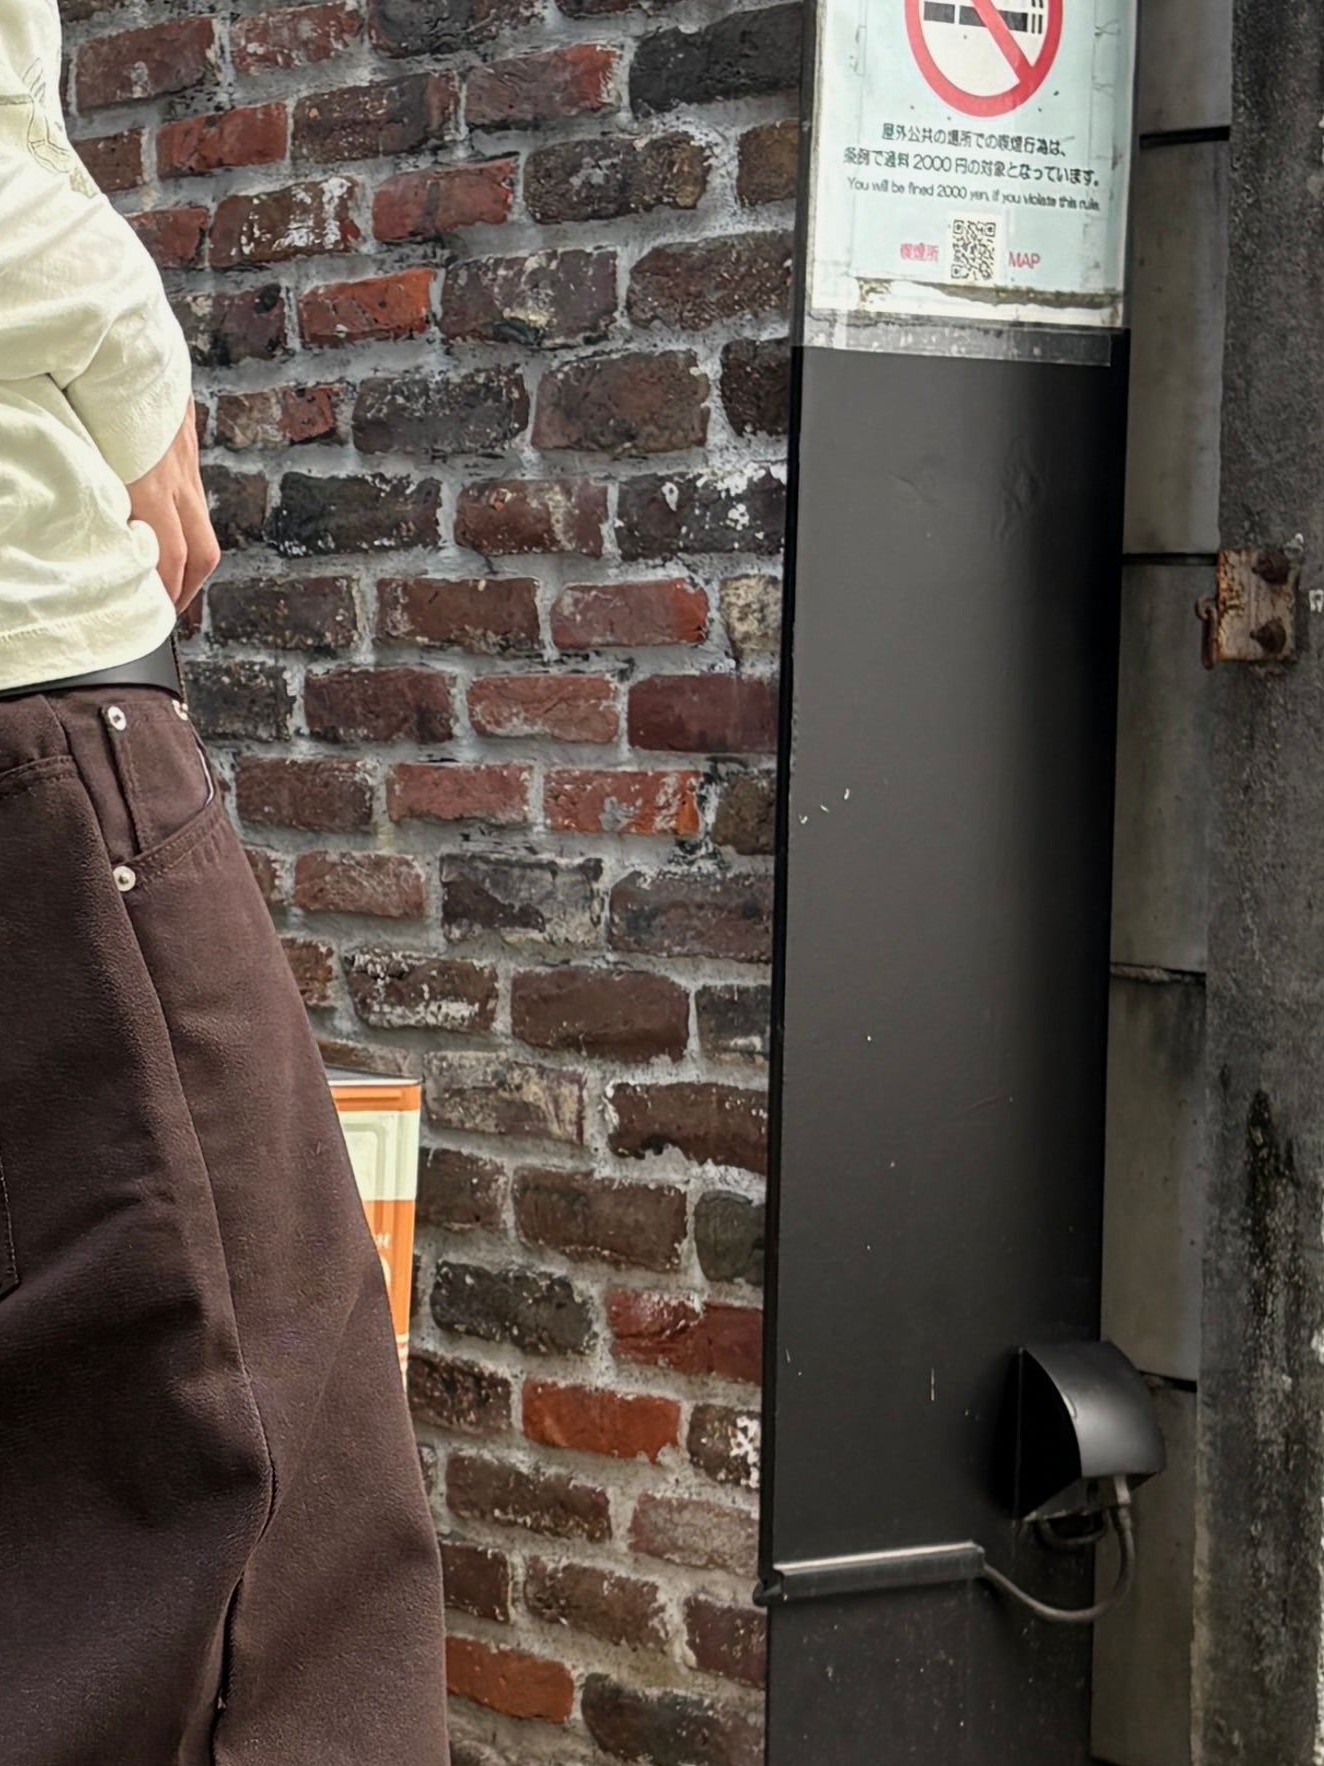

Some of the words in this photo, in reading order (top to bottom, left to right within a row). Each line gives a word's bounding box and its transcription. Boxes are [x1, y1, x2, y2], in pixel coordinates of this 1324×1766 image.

[847, 176, 870, 192] You
[891, 180, 905, 194] be
[908, 181, 934, 197] fined
[936, 184, 968, 200] 2000
[1002, 192, 1021, 205] you
[1008, 251, 1041, 269] MAP
